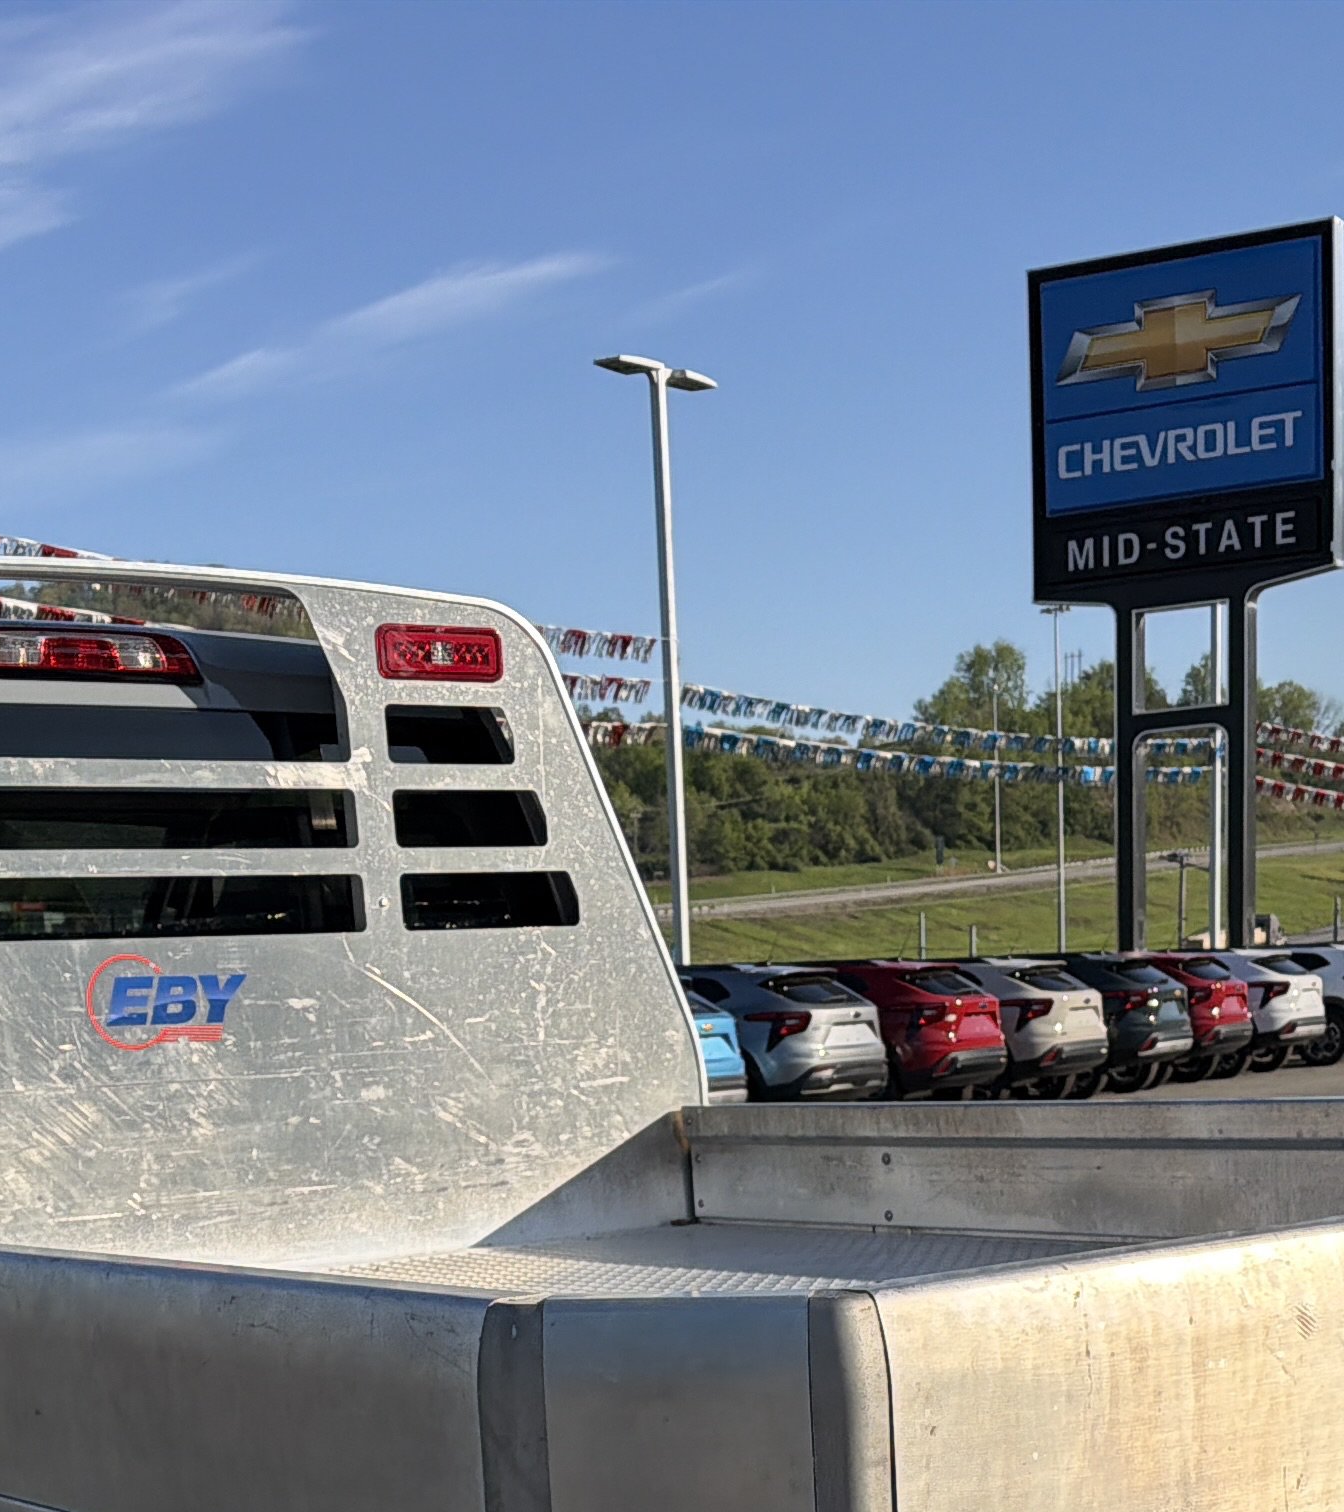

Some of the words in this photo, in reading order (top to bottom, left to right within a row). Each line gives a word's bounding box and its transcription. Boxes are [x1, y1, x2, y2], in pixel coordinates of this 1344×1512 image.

[1057, 409, 1303, 480] CHEVROLET
[1066, 510, 1298, 573] MID-STATE
[106, 973, 248, 1027] EBY
